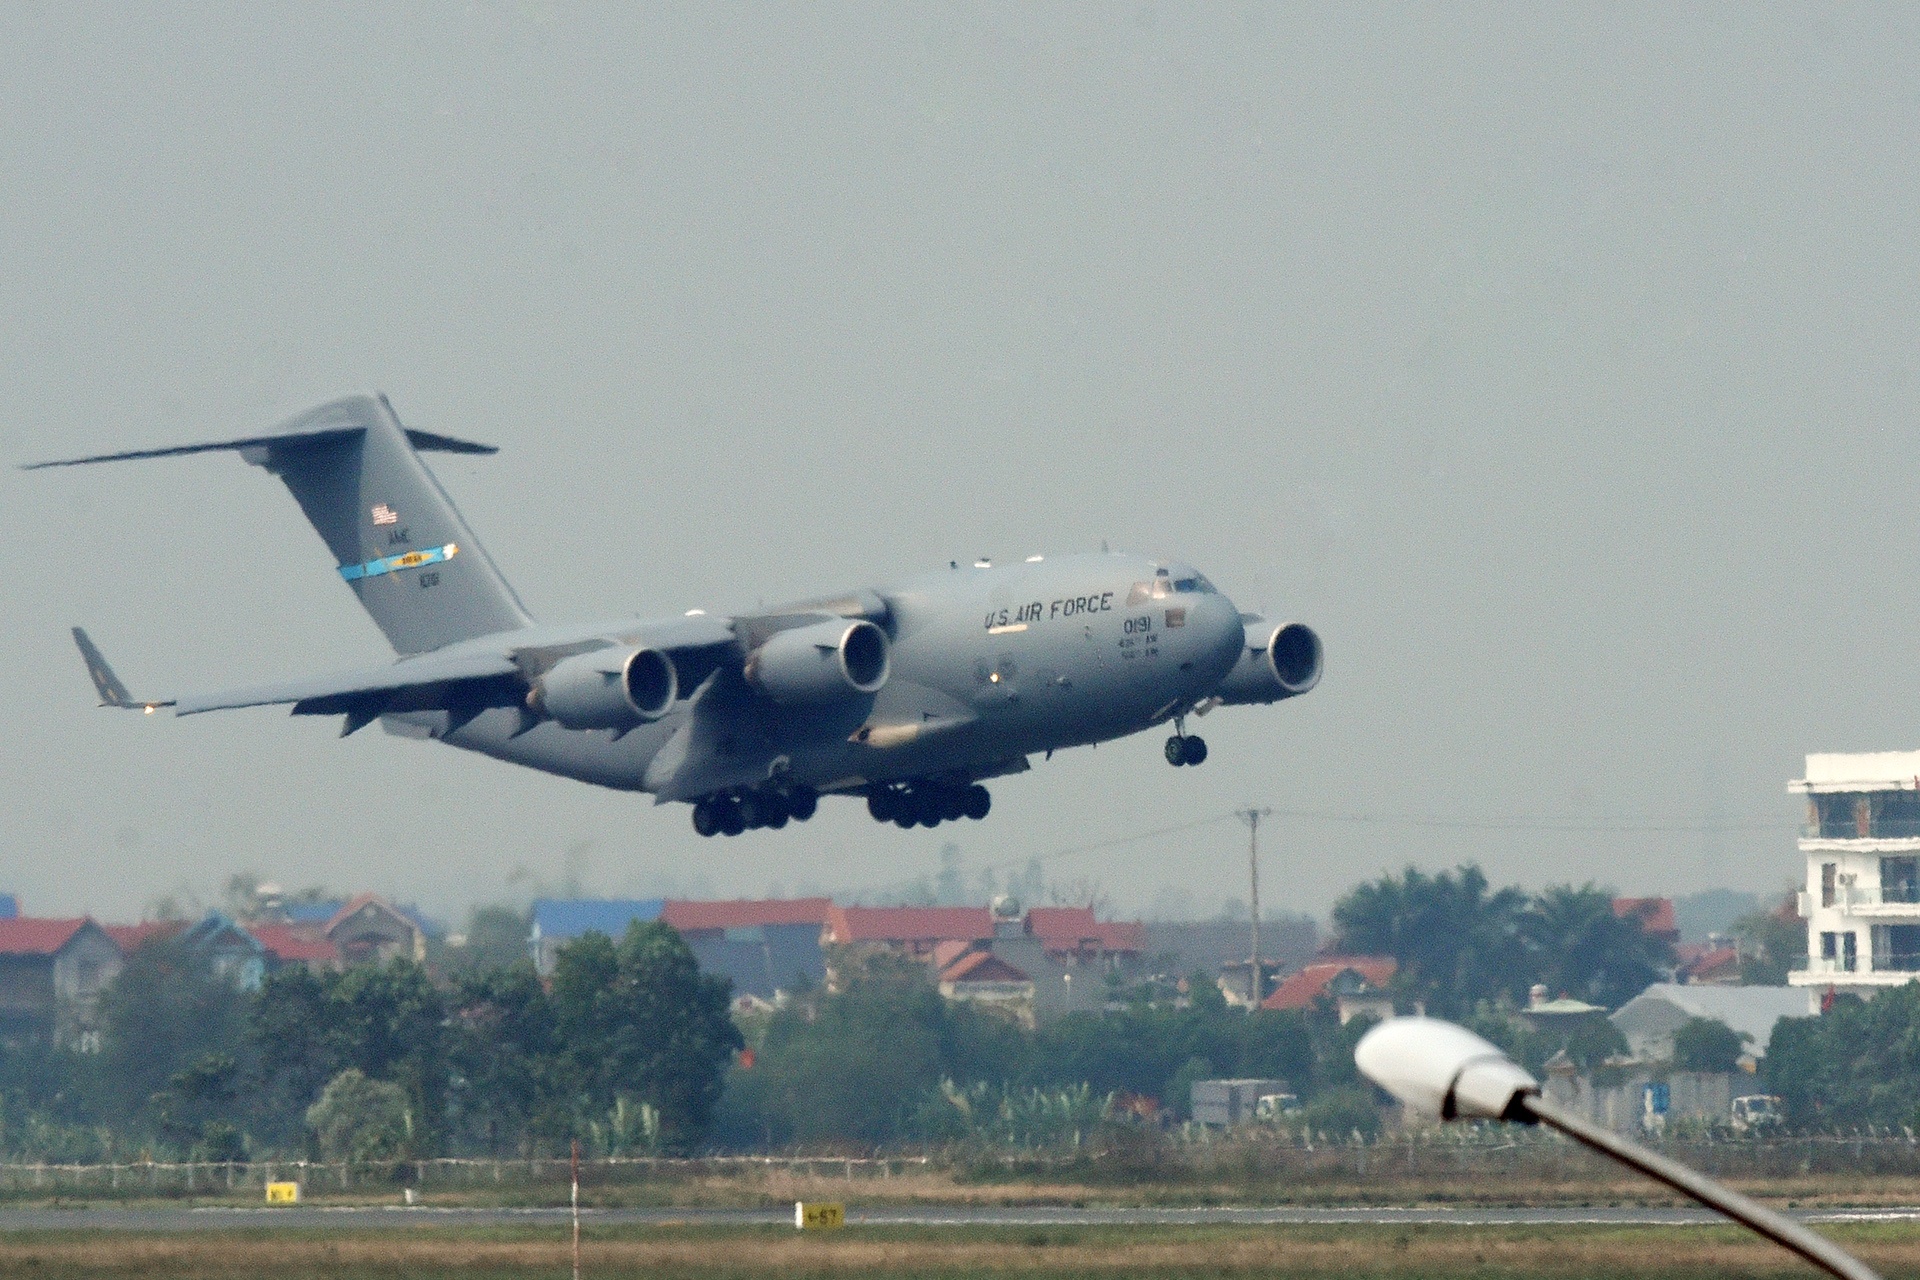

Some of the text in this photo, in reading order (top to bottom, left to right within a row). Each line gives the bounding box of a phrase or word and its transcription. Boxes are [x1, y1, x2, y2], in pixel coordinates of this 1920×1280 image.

[1015, 601, 1043, 621] AIR
[1050, 592, 1114, 620] FORCE
[1123, 615, 1151, 635] 0191
